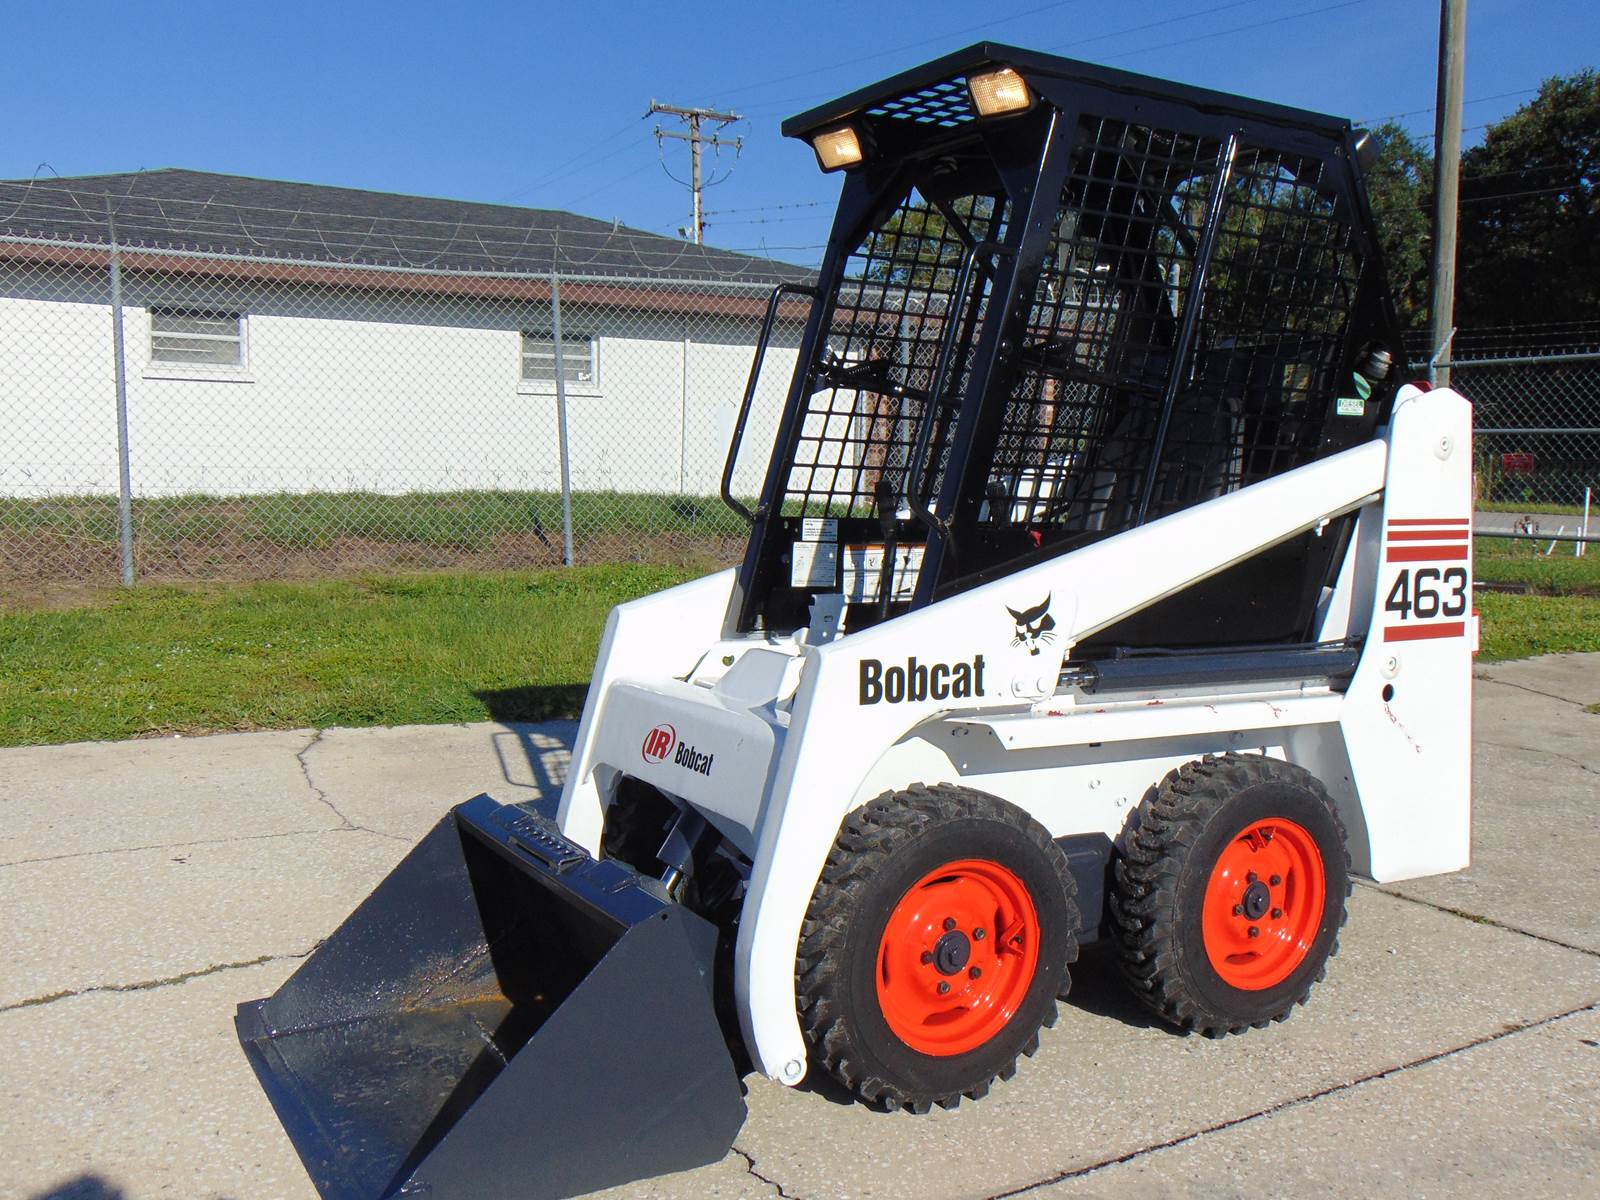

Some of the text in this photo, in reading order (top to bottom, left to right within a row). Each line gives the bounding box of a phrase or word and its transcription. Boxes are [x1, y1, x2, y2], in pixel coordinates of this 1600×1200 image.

[1385, 567, 1467, 620] 463
[859, 654, 985, 706] Bobcat
[646, 728, 714, 776] IR Bobcat
